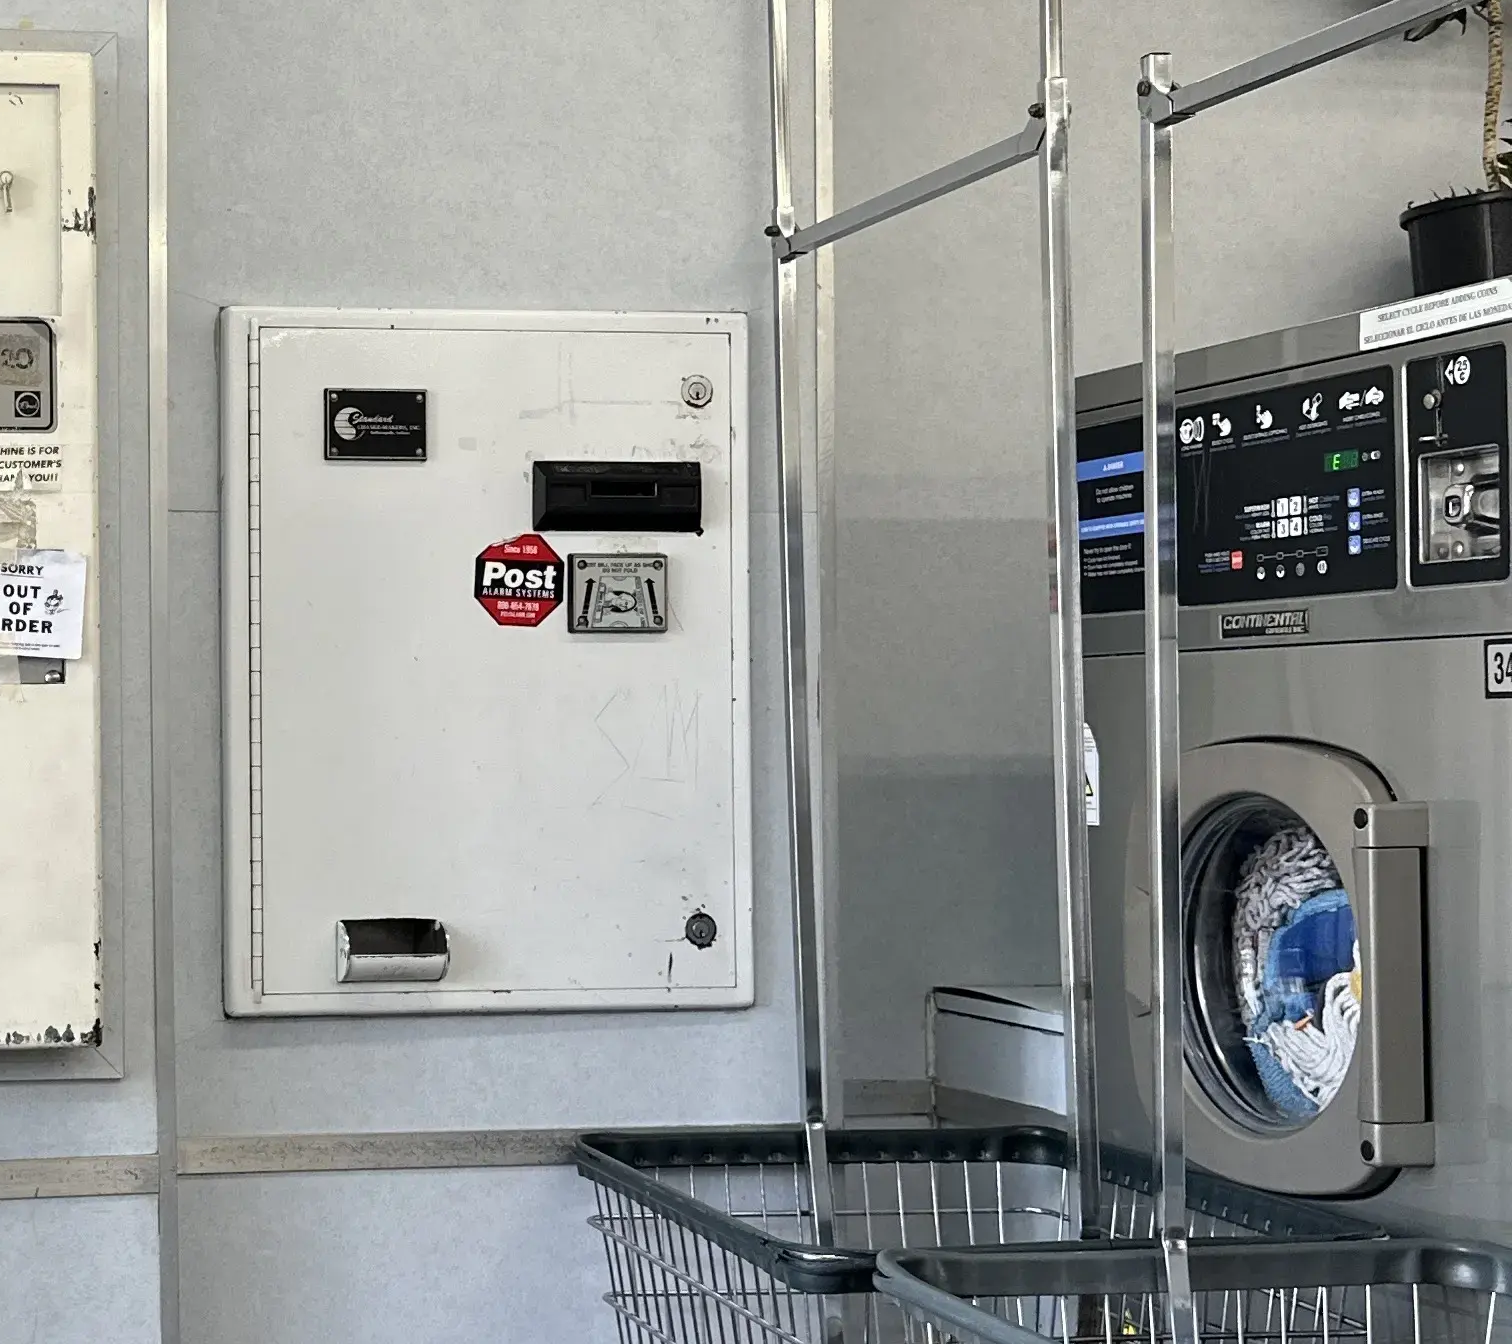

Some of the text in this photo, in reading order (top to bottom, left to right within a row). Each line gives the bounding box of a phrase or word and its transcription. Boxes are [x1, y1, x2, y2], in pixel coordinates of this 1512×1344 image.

[1378, 287, 1498, 322] SELECT CYCLE BEFORE ADDING COINS
[1436, 316, 1457, 326] ANTES
[1459, 313, 1467, 322] DE
[1469, 310, 1481, 320] LAS
[1458, 360, 1467, 371] 25
[28, 447, 35, 455] IS
[39, 446, 59, 454] FOR
[1333, 454, 1340, 470] E
[29, 473, 58, 482] YOU!!
[1280, 503, 1285, 514] 1
[1293, 522, 1299, 532] 4
[504, 545, 520, 554] Since
[1, 563, 44, 575] SORRY
[482, 561, 557, 589] Post
[3, 584, 41, 598] OUT
[482, 587, 554, 599] ALARM SYSTEMS
[9, 602, 33, 615] OF
[1223, 611, 1305, 629] CONTINENTAL
[1494, 652, 1512, 684] 34
